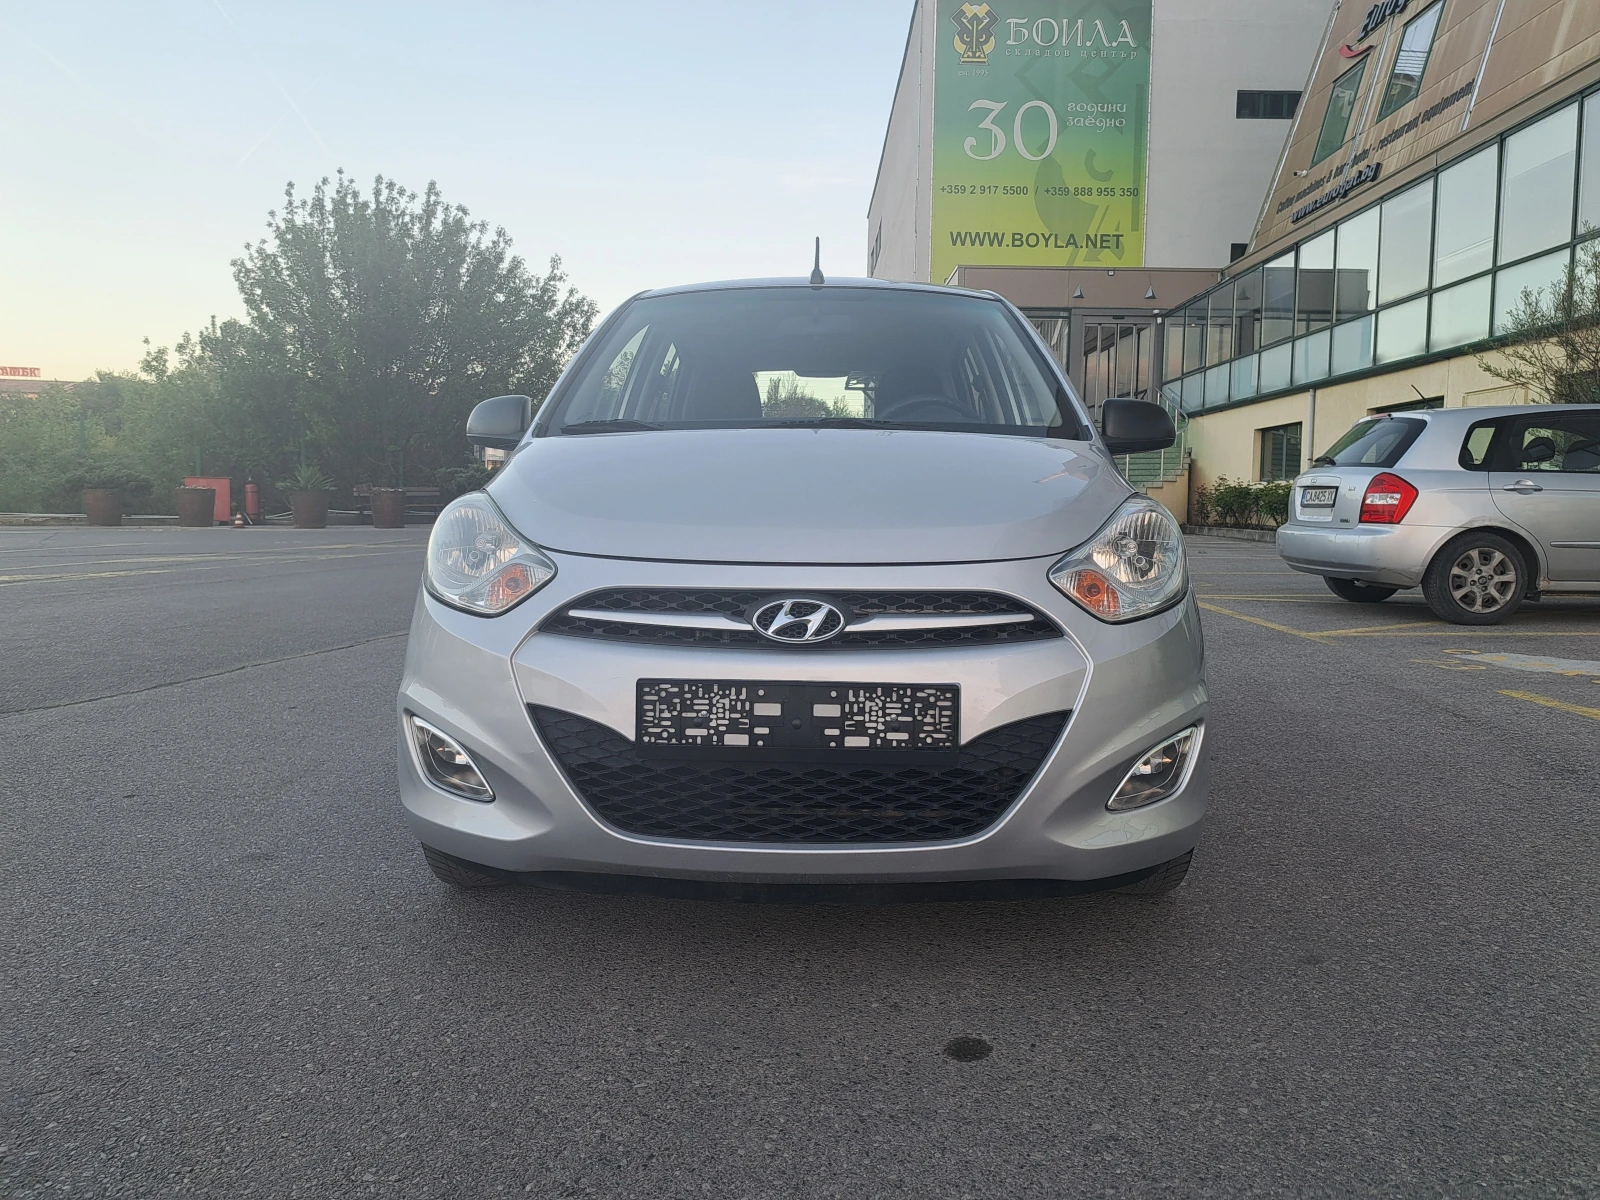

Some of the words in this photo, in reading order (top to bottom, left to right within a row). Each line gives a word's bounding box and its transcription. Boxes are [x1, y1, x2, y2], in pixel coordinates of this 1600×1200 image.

[1005, 17, 1138, 48] БОИЛА
[1005, 49, 1071, 58] складов
[1080, 50, 1138, 60] център
[1067, 102, 1128, 117] години
[1376, 111, 1422, 152] restaurant
[1421, 77, 1476, 125] equipment
[963, 99, 1058, 162] 30
[1066, 117, 1126, 133] заедно
[940, 185, 967, 195] +359
[969, 185, 977, 195] 2
[979, 185, 999, 195] 917
[1002, 185, 1029, 196] 5500
[1044, 186, 1070, 196] +359
[1073, 186, 1093, 197] 888
[1096, 187, 1116, 197] 955
[1119, 187, 1139, 197] 350
[1290, 162, 1379, 224] www.eurogat.bg
[949, 231, 1125, 250] WWW.BOYLA.NET
